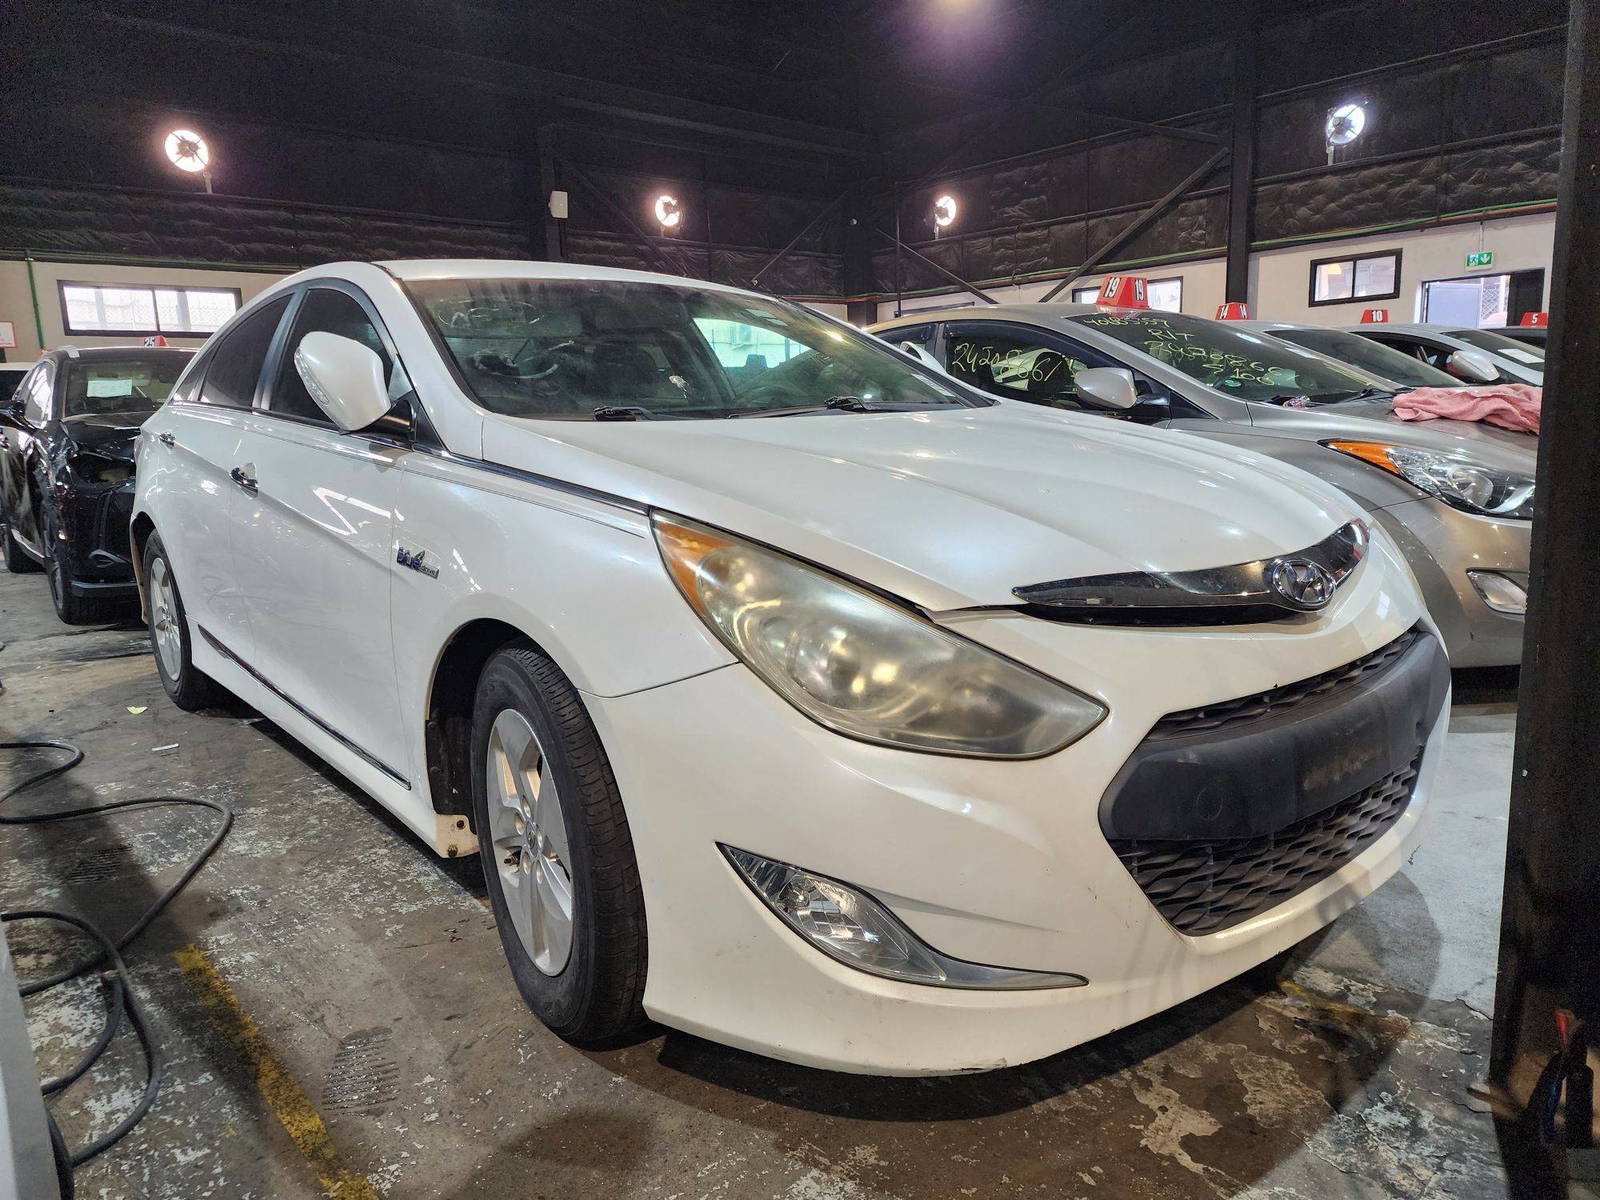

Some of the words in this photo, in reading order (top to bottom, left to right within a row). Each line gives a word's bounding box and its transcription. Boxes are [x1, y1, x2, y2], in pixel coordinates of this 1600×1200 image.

[1104, 276, 1120, 298] 19
[1134, 279, 1144, 301] 19
[1371, 310, 1383, 322] 10
[1531, 313, 1539, 324] 5
[144, 337, 155, 348] 25
